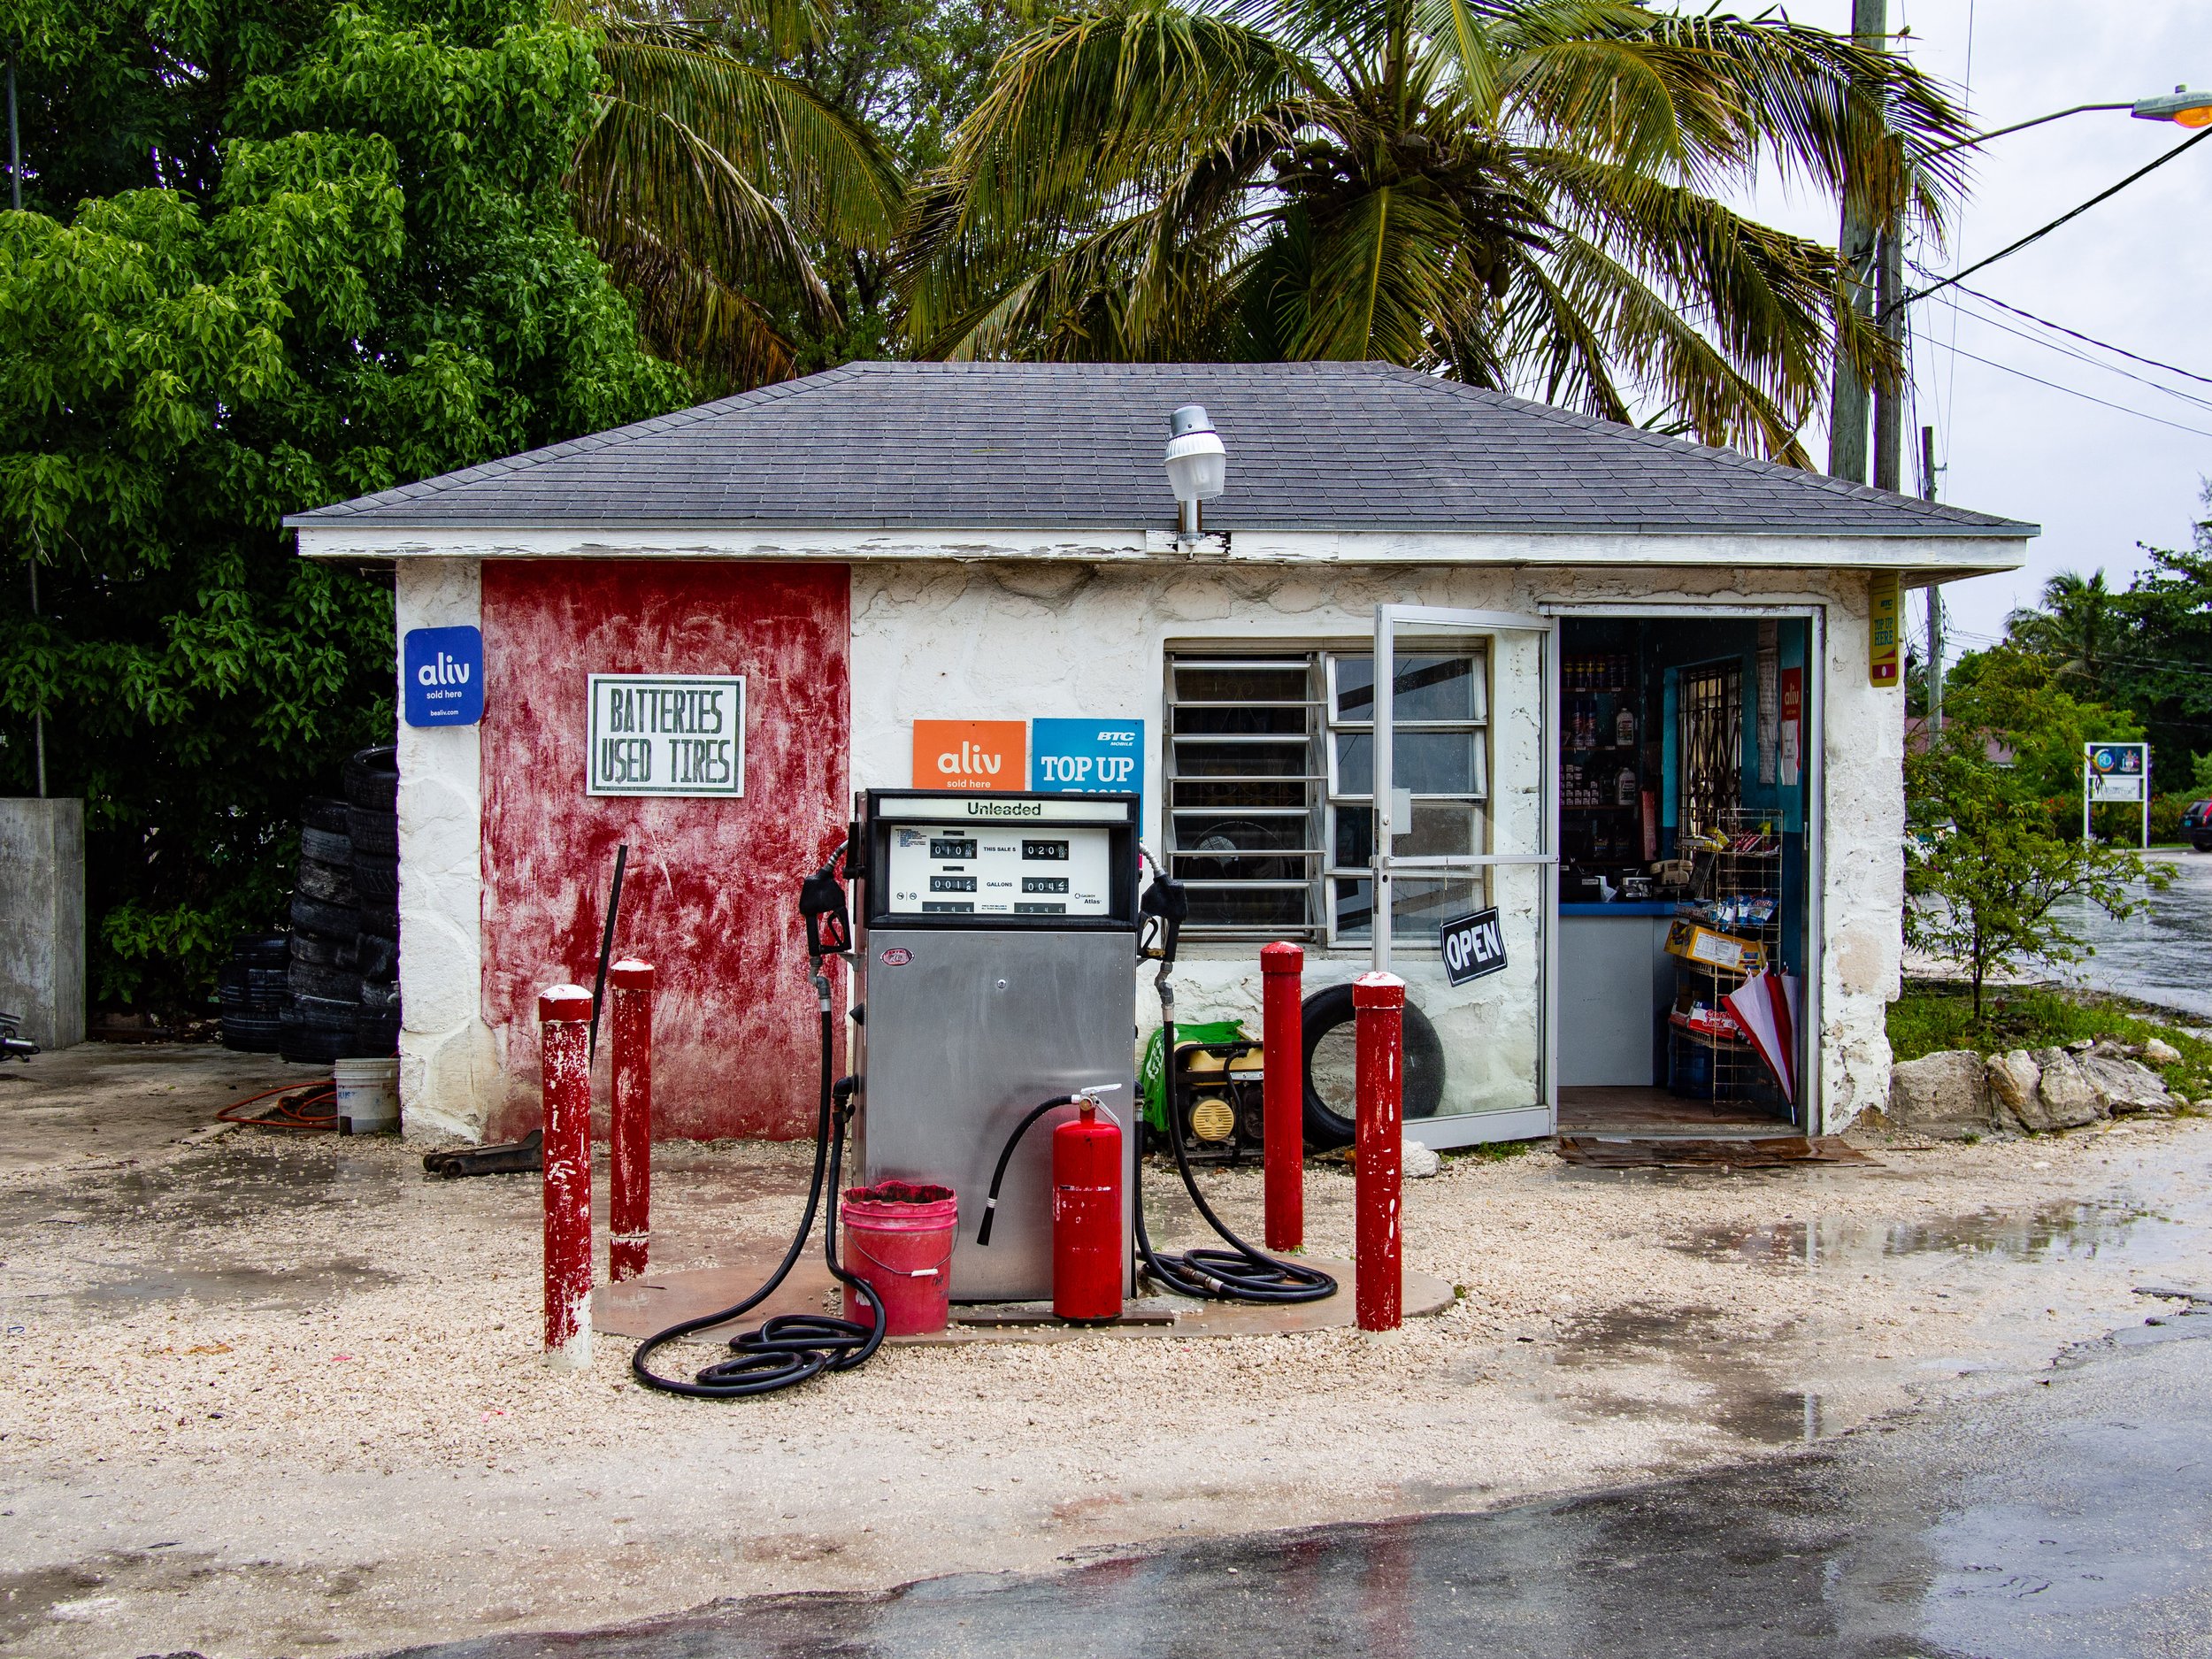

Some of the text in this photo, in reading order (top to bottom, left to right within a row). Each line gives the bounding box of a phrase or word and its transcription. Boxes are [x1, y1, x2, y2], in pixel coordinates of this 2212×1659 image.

[1874, 617, 1893, 630] TOP UP
[1874, 630, 1893, 646] HERE
[419, 652, 470, 686] aliv
[426, 690, 443, 699] sold
[1785, 682, 1799, 705] aliv
[610, 688, 724, 733] BATTERIES
[1097, 732, 1135, 741] BTC
[601, 738, 731, 783] USED TIRES
[937, 741, 1002, 774] aliv
[1041, 756, 1134, 782] TOP UP
[969, 780, 991, 788] here
[967, 802, 1041, 816] Unleaded
[1446, 920, 1502, 971] OPEN
[1702, 1018, 1725, 1027] Jack
